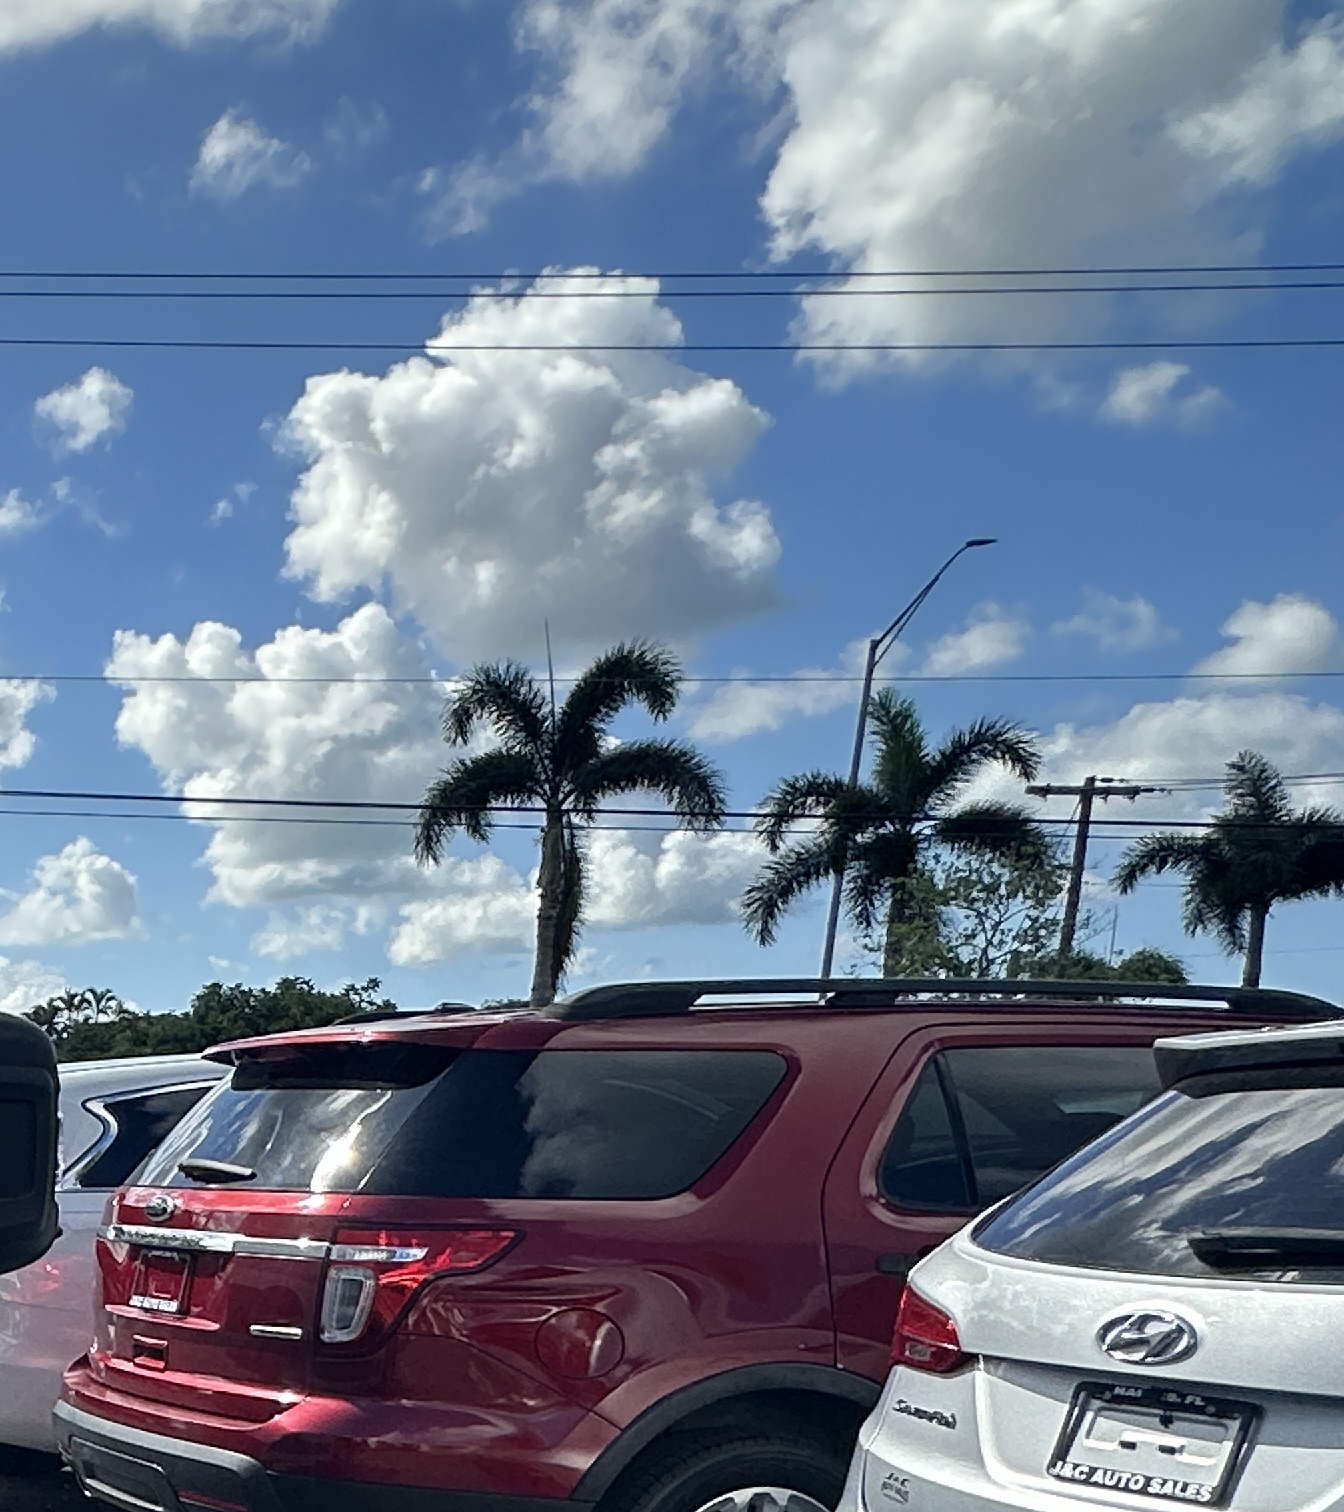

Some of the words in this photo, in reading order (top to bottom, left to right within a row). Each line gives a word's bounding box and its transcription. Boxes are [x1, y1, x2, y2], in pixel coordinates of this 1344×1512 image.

[1049, 1460, 1089, 1481] J&C
[1090, 1468, 1147, 1490] AUTO
[1147, 1477, 1213, 1502] SALES
